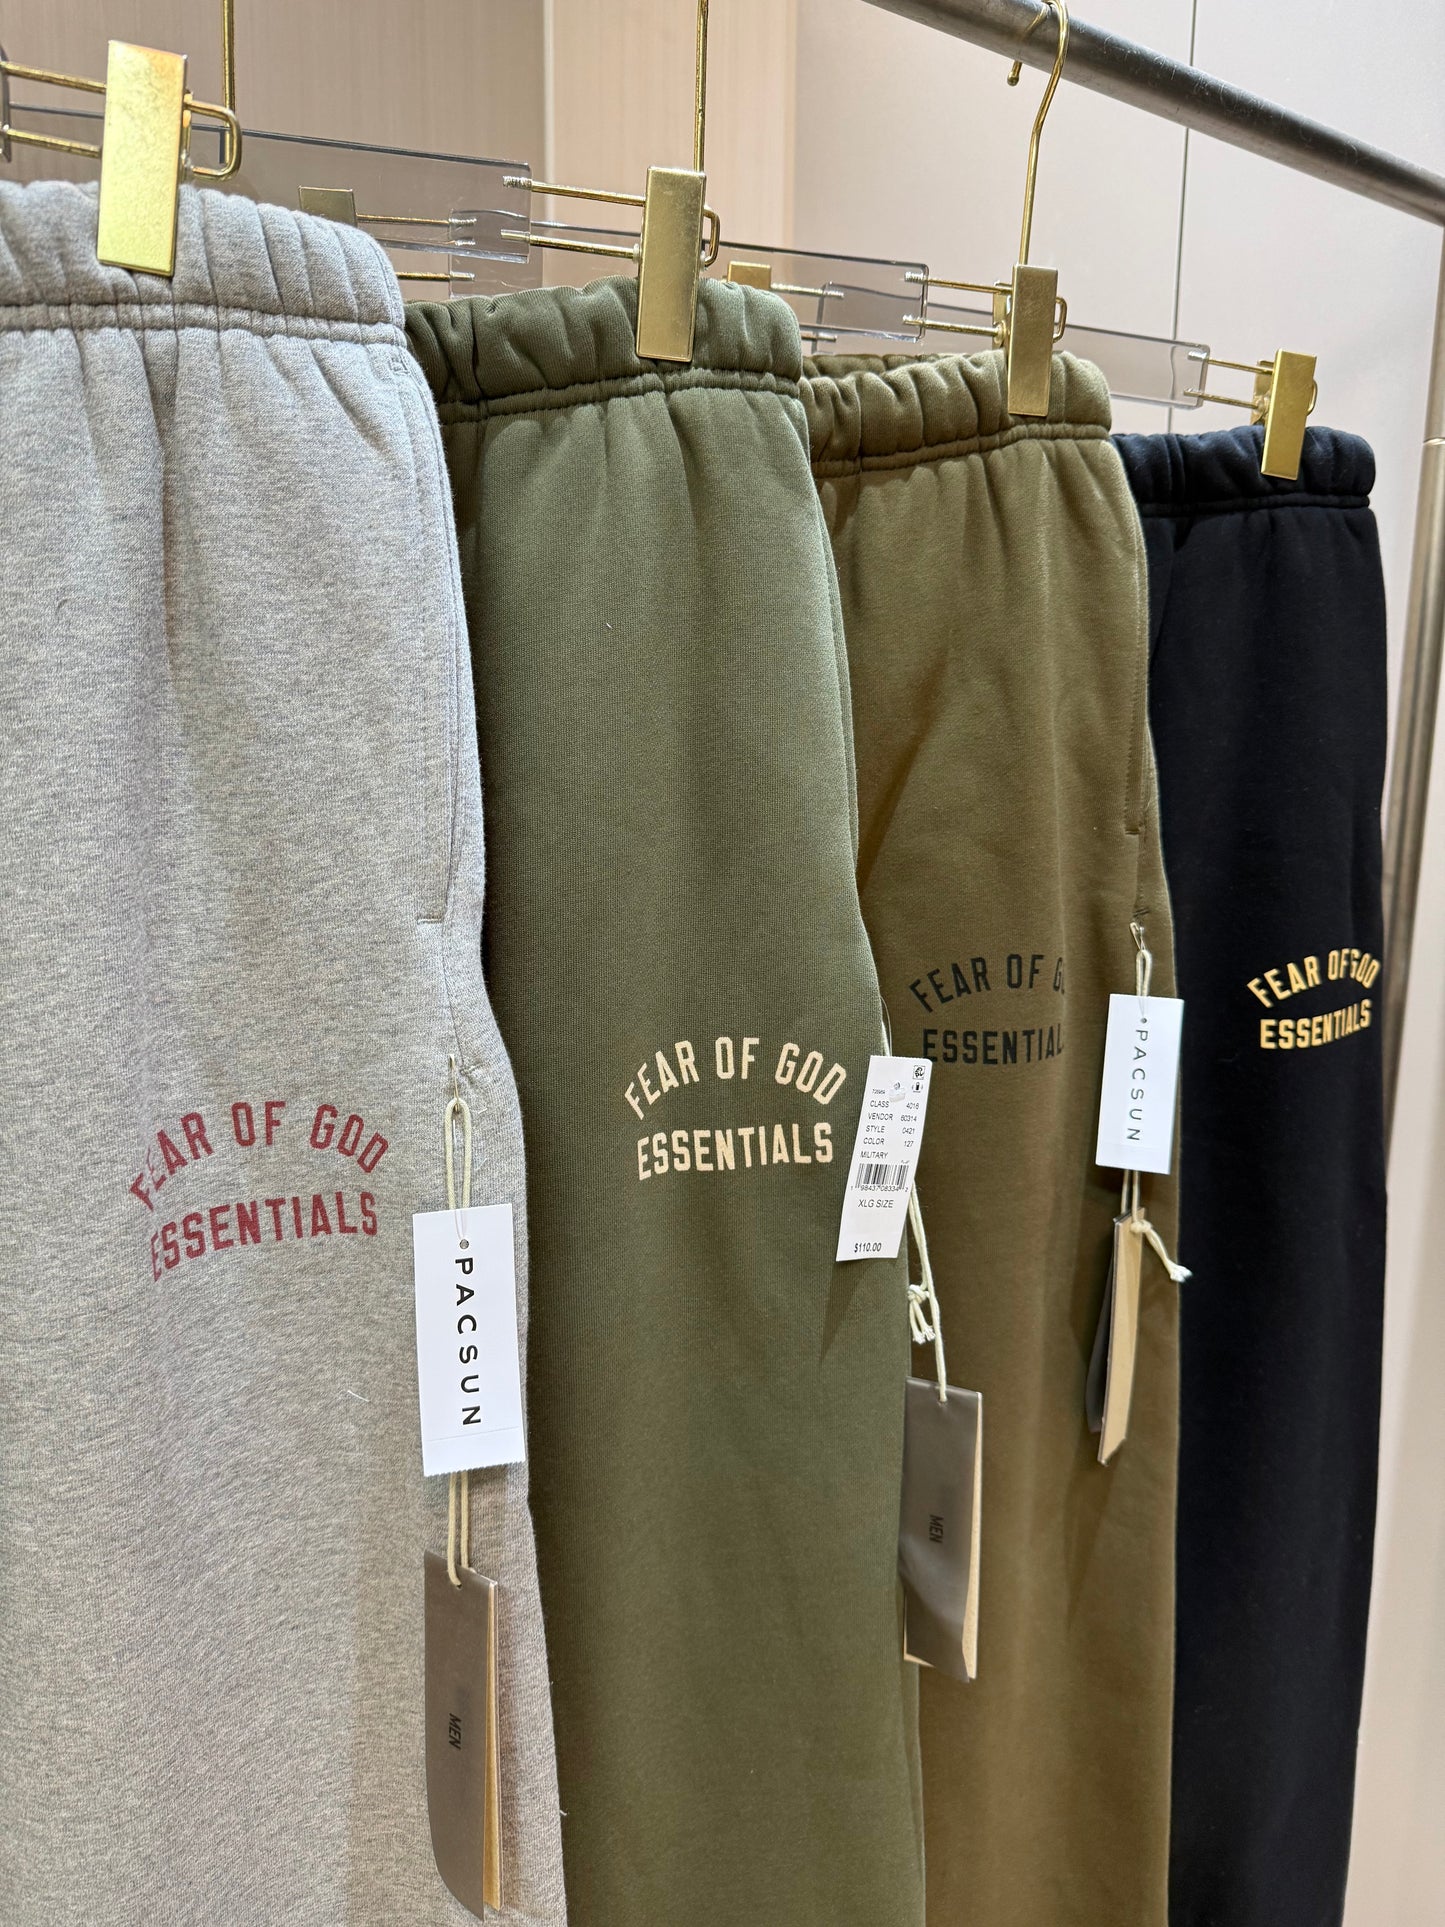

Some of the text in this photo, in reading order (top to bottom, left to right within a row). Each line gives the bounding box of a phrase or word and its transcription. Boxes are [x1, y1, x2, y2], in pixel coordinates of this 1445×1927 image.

[909, 953, 1065, 1013] FEAR OF G
[1246, 948, 1381, 1008] FEAR OF GOD
[1259, 998, 1372, 1050] ESSENTIALS
[624, 1036, 847, 1120] FEAR OF GOD
[1126, 1029, 1149, 1141] PACSUN
[868, 1112, 893, 1121] VENDOR
[869, 1100, 890, 1108] CLASS
[637, 1122, 833, 1181] ESSENTIALS
[863, 1137, 914, 1148] COLOR 127
[865, 1125, 885, 1133] STYLE
[129, 1100, 389, 1212] FEAR OF GOD
[860, 1150, 888, 1159] MILITARY
[858, 1199, 894, 1208] XLG SIZE
[150, 1191, 378, 1282] ESSENTIALS
[854, 1242, 882, 1253] $110.00
[455, 1257, 482, 1426] PACSUN
[929, 1514, 944, 1544] MEN
[449, 1712, 462, 1751] MEN
